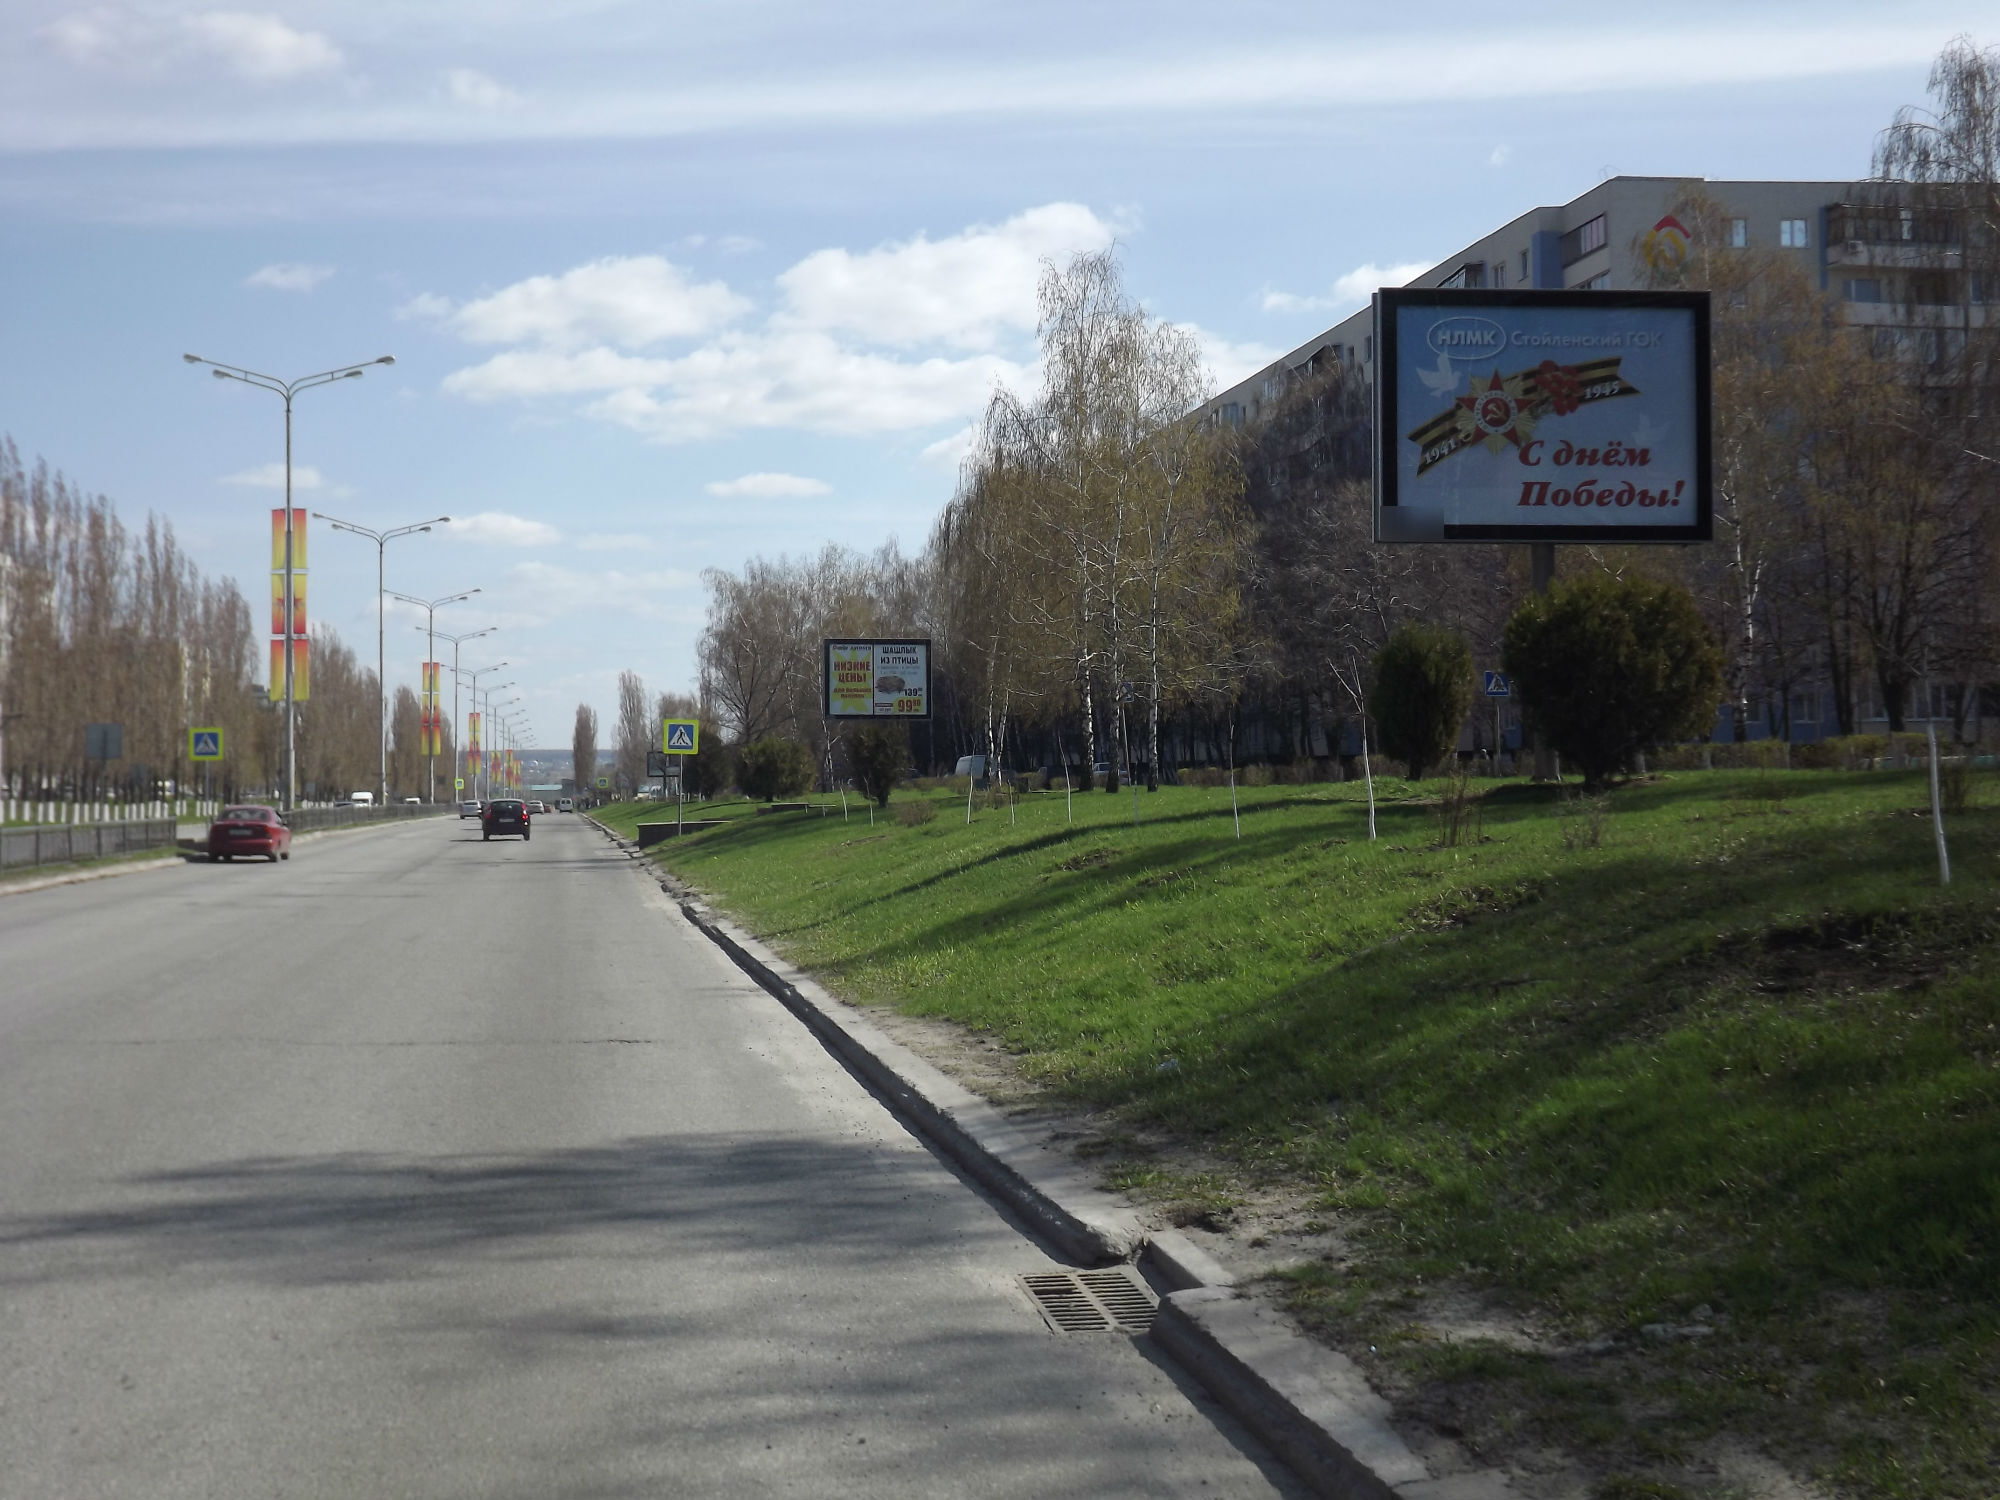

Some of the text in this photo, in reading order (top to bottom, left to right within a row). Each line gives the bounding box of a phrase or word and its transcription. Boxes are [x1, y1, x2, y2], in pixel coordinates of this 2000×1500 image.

[1437, 329, 1497, 347] НЛМК
[1510, 330, 1664, 348] Стойленский ГОК
[1584, 381, 1620, 399] 1945
[1424, 439, 1458, 465] 1941
[1518, 440, 1651, 467] С днём
[1516, 479, 1686, 508] Победы!
[834, 662, 871, 671] НИЗКИЕ
[892, 656, 919, 665] ПТИЦЫ
[839, 672, 866, 683] ЦЕНЫ
